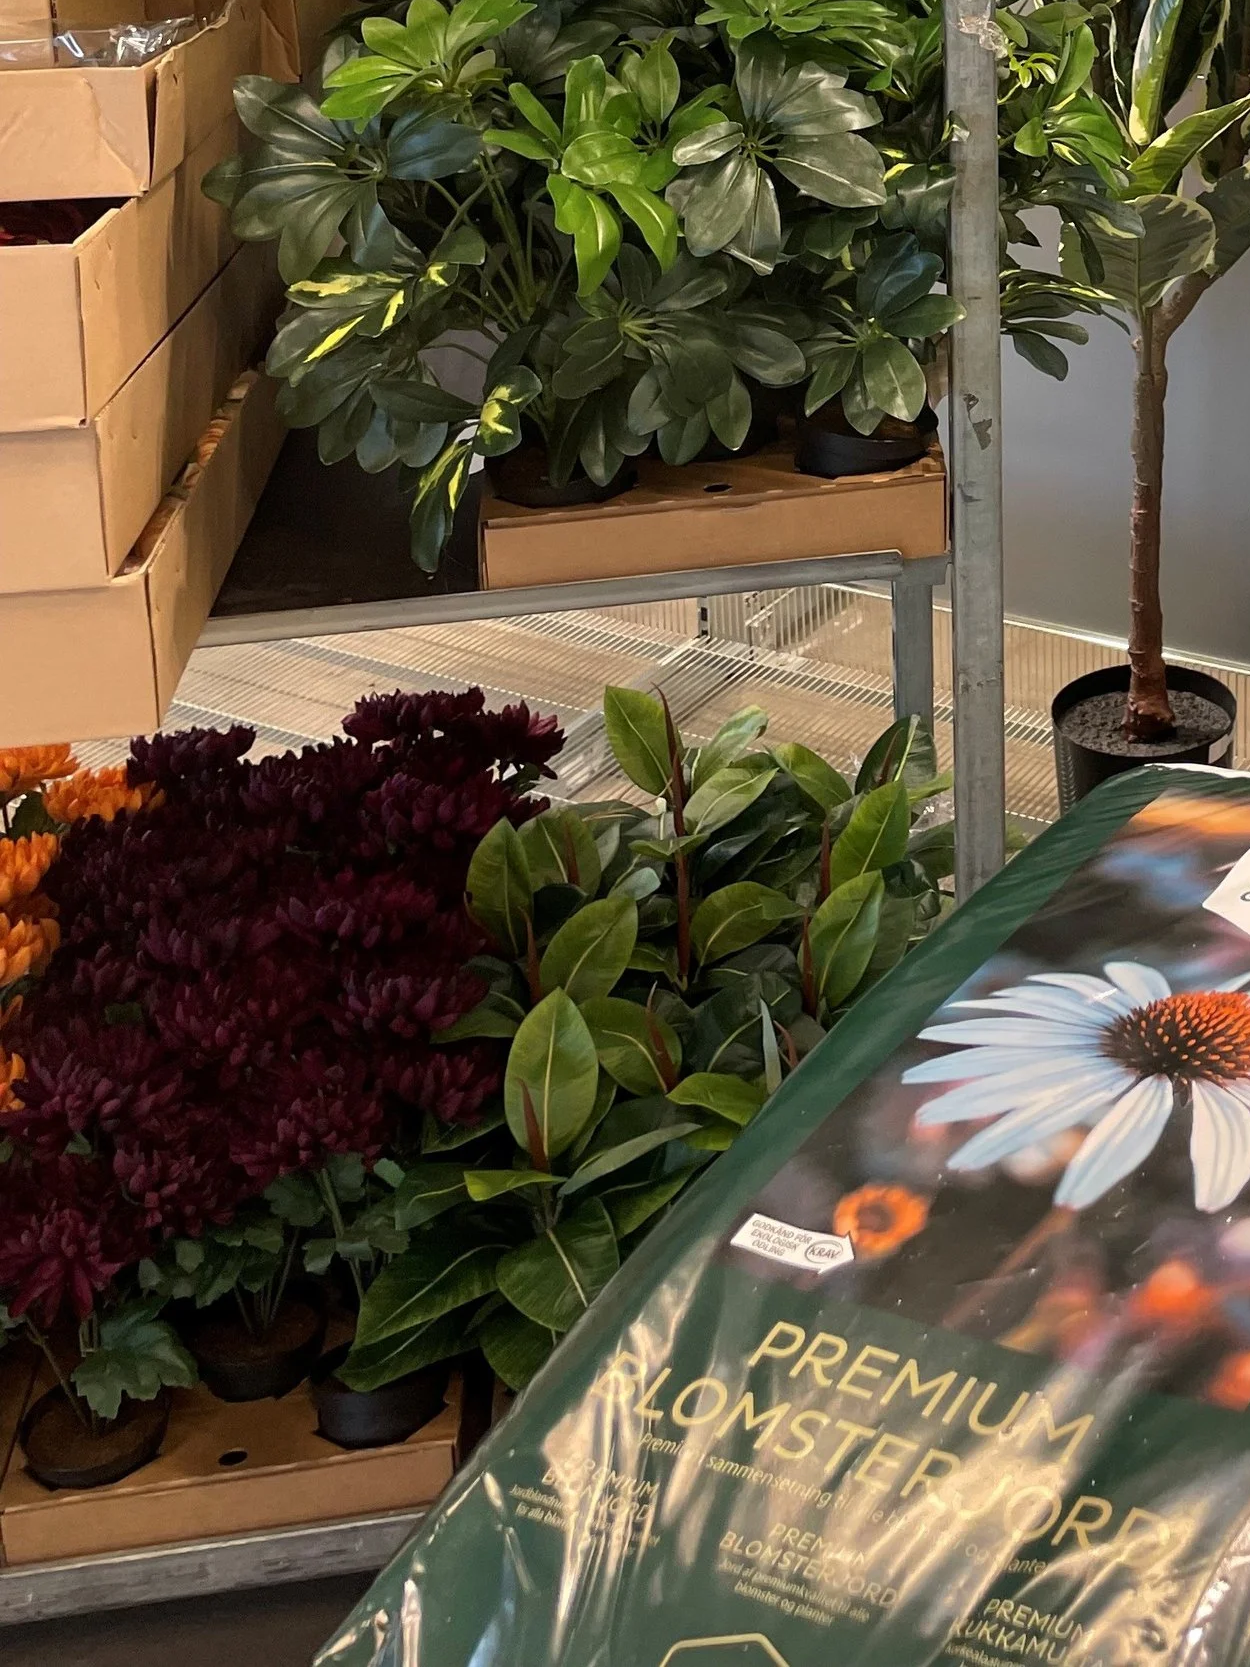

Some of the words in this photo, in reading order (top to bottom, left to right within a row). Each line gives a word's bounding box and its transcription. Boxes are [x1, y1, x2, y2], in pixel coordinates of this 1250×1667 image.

[808, 1245, 841, 1260] KRAV
[748, 1320, 1095, 1464] PREMIUM
[719, 1531, 898, 1607] BLOMSTERJORD
